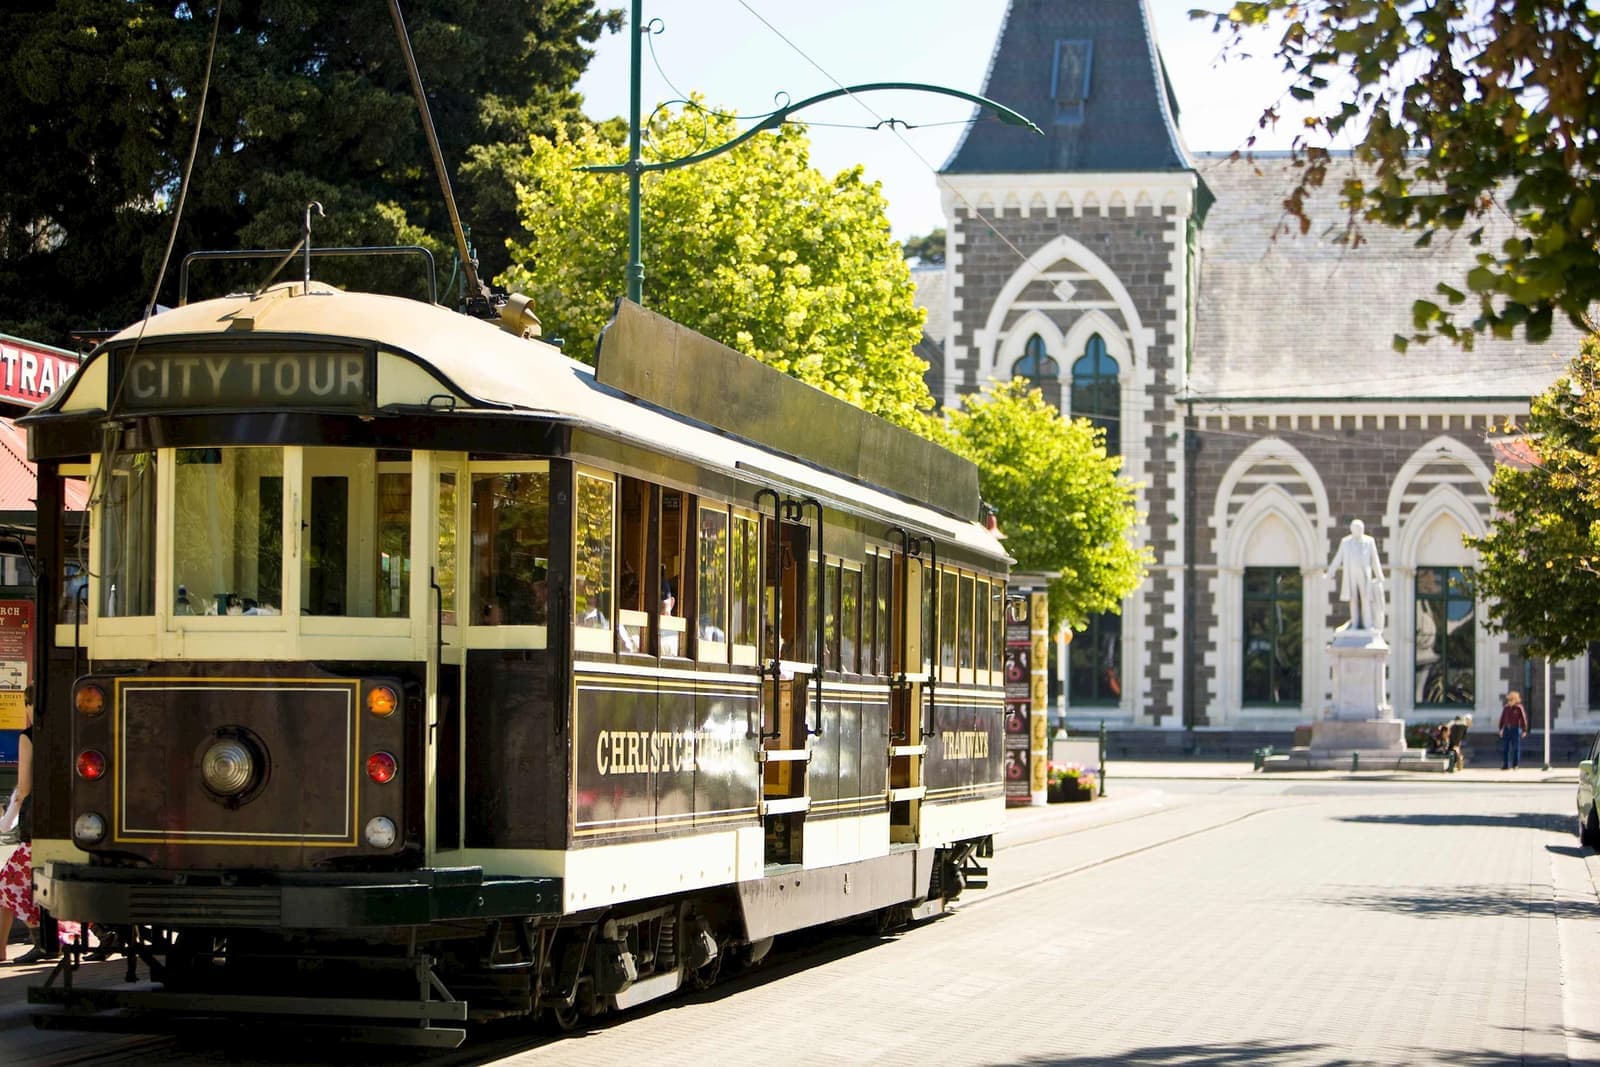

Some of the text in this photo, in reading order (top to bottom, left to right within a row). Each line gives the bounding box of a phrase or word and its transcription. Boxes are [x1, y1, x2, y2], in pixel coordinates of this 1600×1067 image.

[131, 355, 365, 399] CITY TOUR
[597, 729, 743, 776] CHRISTCHUH
[942, 730, 989, 760] TRAMWAYS
